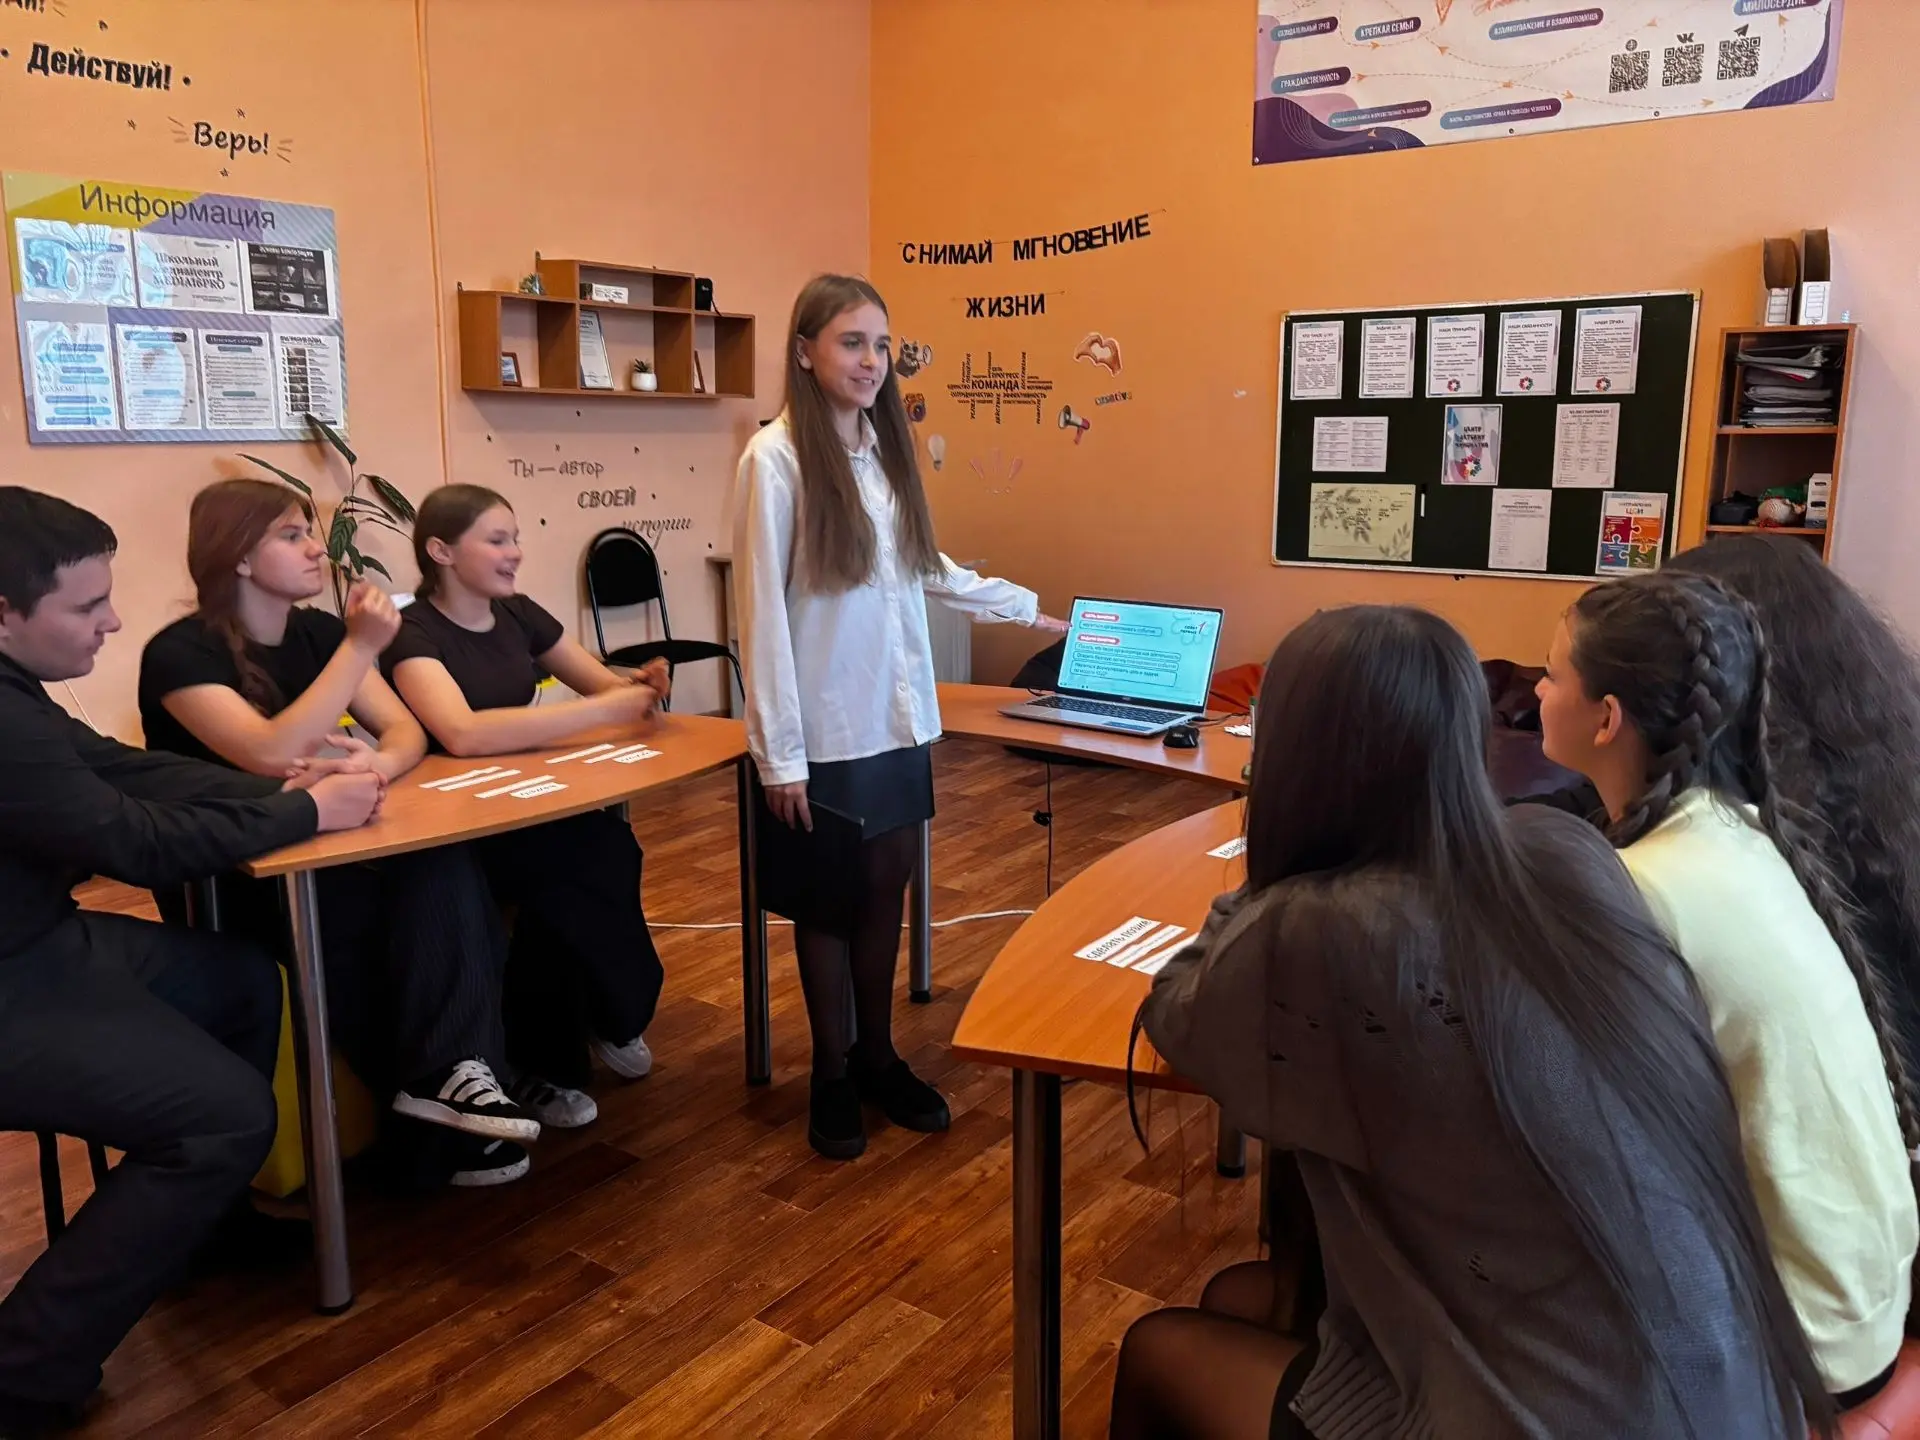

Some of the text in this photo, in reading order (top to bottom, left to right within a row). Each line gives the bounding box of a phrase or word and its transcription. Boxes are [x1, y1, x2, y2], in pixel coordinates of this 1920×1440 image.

[1360, 20, 1414, 37] КРЕПКАЯ СЕМЬЯ
[27, 41, 172, 91] Действуй!
[1280, 72, 1341, 89] ГРАЖДАНСТВЕННОСТЬ
[194, 121, 269, 161] Верь!
[80, 183, 276, 231] Информация
[902, 213, 1151, 265] СНИМАЙ МГНОВЕНИЕ
[965, 294, 1046, 318] ЖИЗНИ
[971, 379, 1020, 392] КОМАНДА
[577, 485, 637, 509] СВОЕЙ
[622, 517, 693, 551] истории
